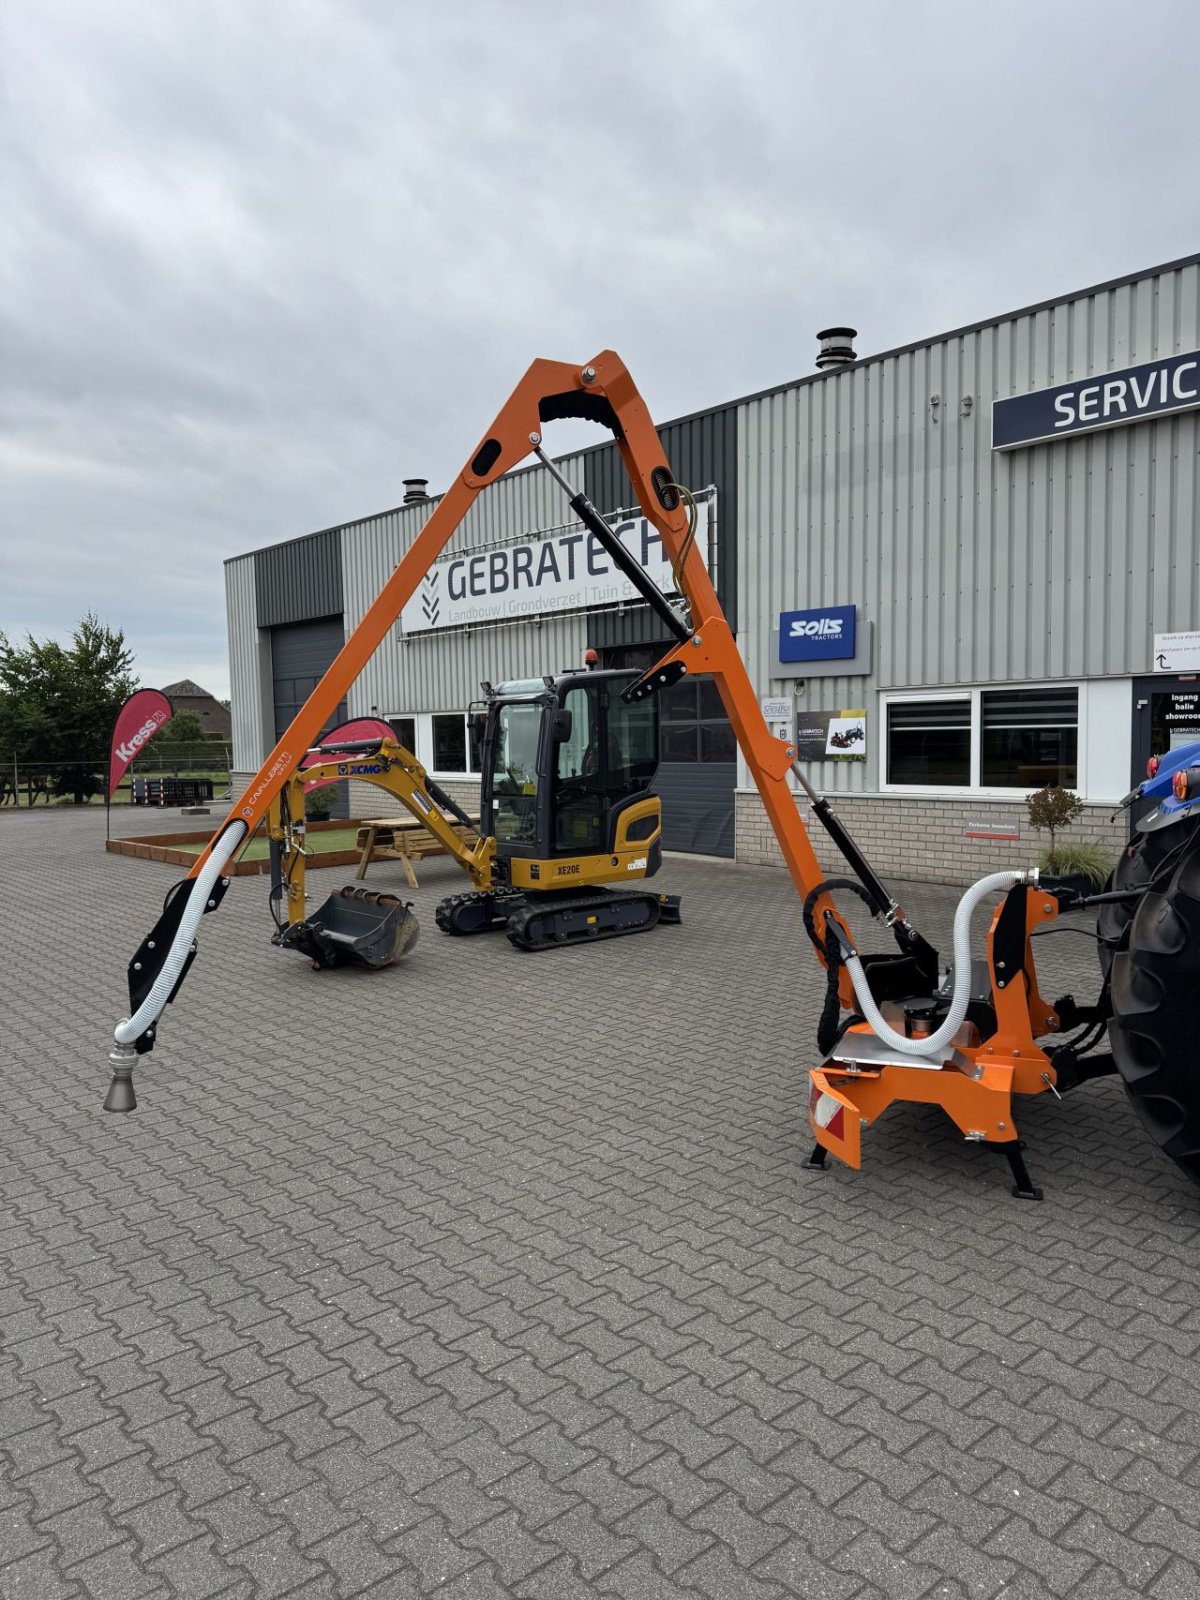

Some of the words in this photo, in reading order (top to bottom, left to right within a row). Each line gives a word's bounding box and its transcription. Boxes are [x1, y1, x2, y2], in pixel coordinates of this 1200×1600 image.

[449, 604, 501, 622] Landbouw
[508, 590, 583, 613] Grondverzet
[591, 585, 619, 601] Tuin
[622, 583, 633, 596] &
[811, 633, 843, 641] TRACTORS
[1171, 694, 1198, 702] Ingang
[115, 719, 157, 763] Kress
[350, 765, 381, 775] XCMG
[249, 751, 289, 805] CAVALLERETTI
[558, 864, 580, 875] XE20E
